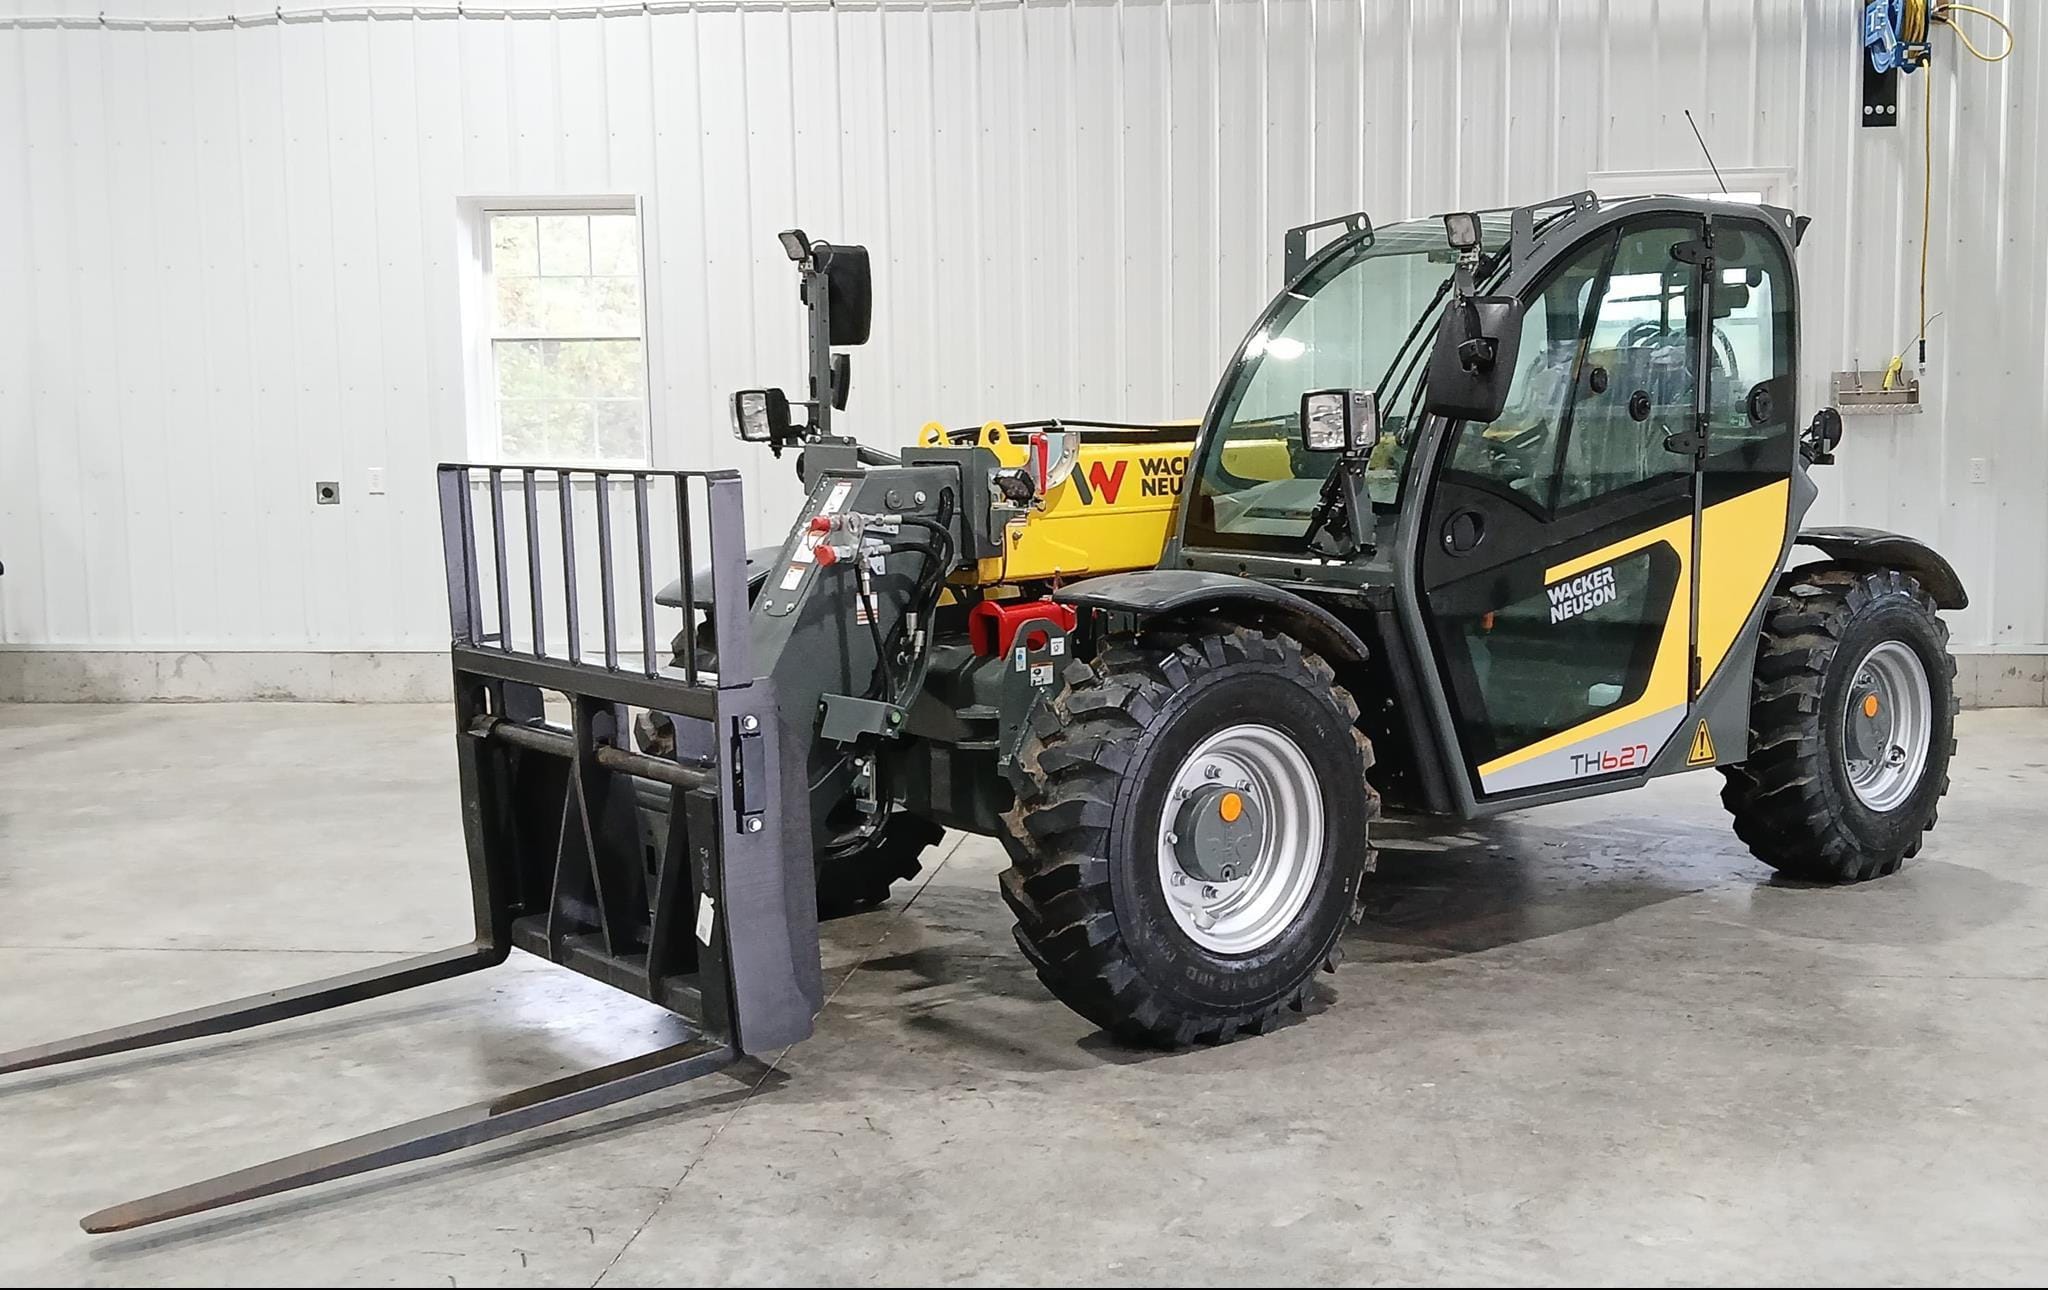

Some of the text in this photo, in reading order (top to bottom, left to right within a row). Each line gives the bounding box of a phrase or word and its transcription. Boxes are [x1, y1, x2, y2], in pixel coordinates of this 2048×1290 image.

[1141, 477, 1184, 496] NEU
[1547, 566, 1615, 605] WACKER
[1550, 582, 1616, 624] NEUSON
[1570, 744, 1648, 775] TH627
